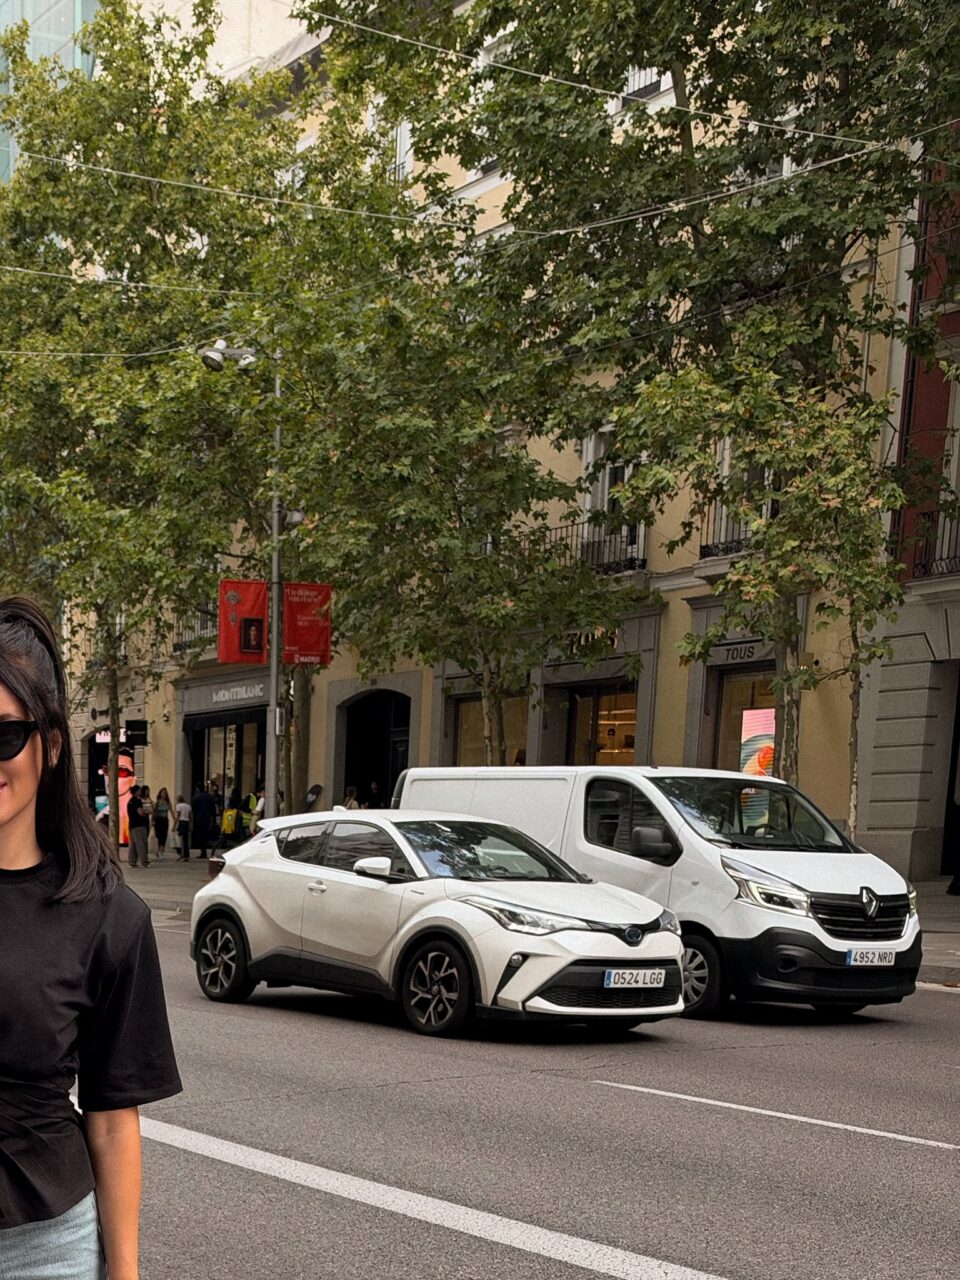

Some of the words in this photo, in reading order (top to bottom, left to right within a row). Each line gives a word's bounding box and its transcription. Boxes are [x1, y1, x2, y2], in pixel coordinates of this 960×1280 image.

[300, 656, 320, 664] MADRID
[725, 646, 755, 661] TOUS
[212, 684, 264, 702] MONTBLANC
[853, 951, 876, 964] 4952
[878, 951, 894, 964] NRD
[613, 972, 640, 985] 0524
[642, 971, 662, 985] LGG
